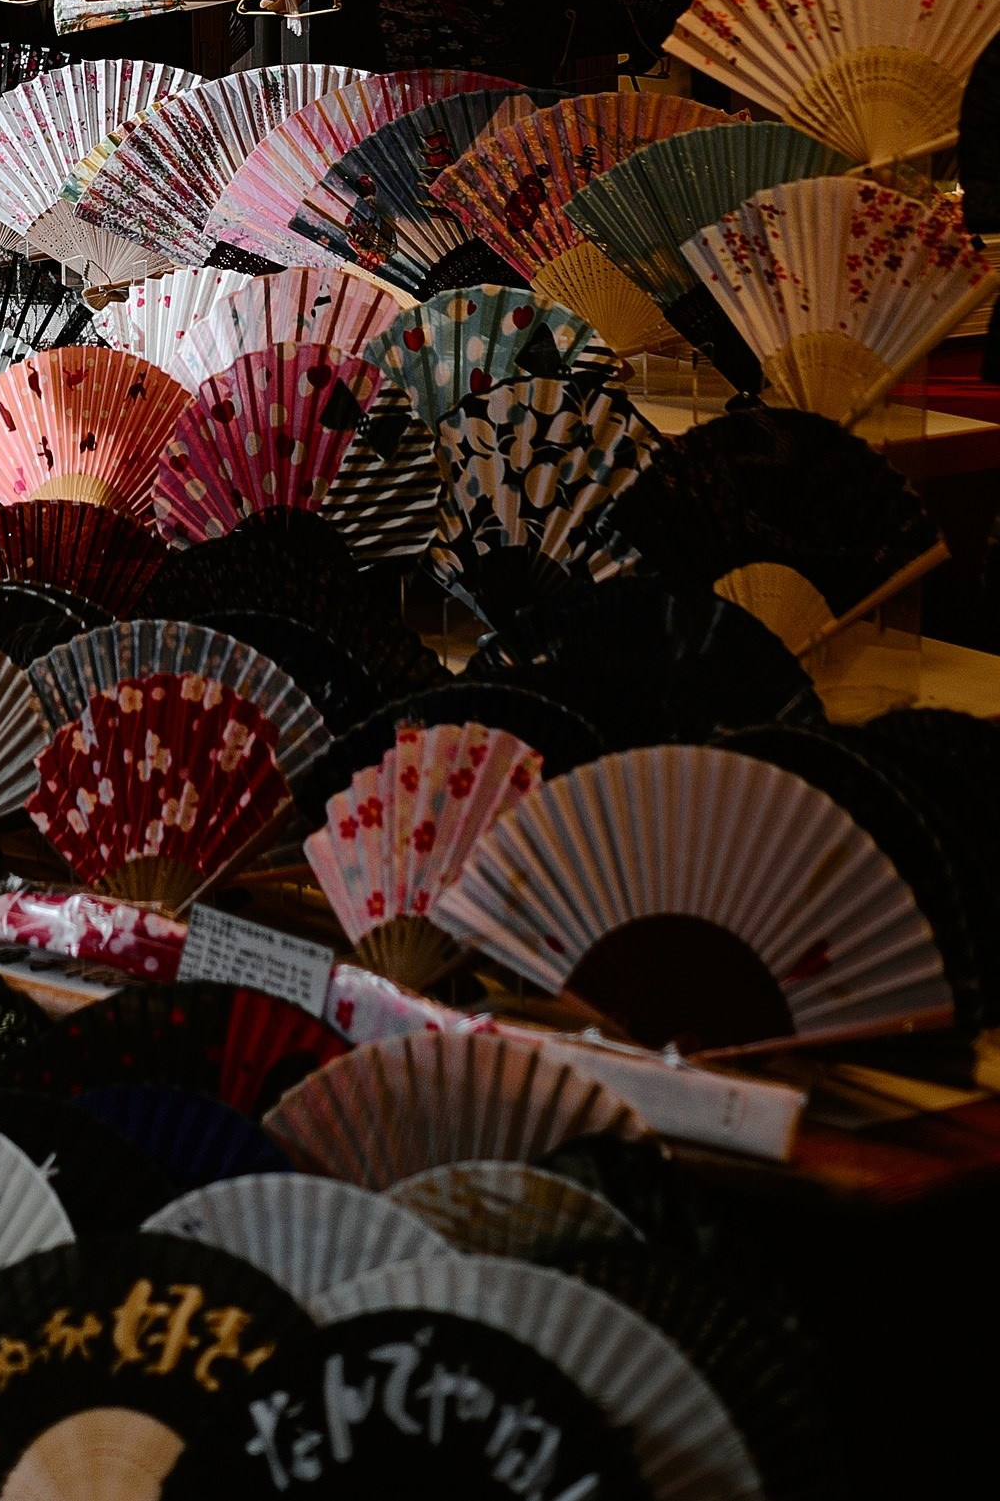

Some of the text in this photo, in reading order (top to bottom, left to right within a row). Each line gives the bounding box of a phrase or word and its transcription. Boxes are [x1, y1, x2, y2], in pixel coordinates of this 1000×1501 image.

[245, 1324, 600, 1501] なんでやね
